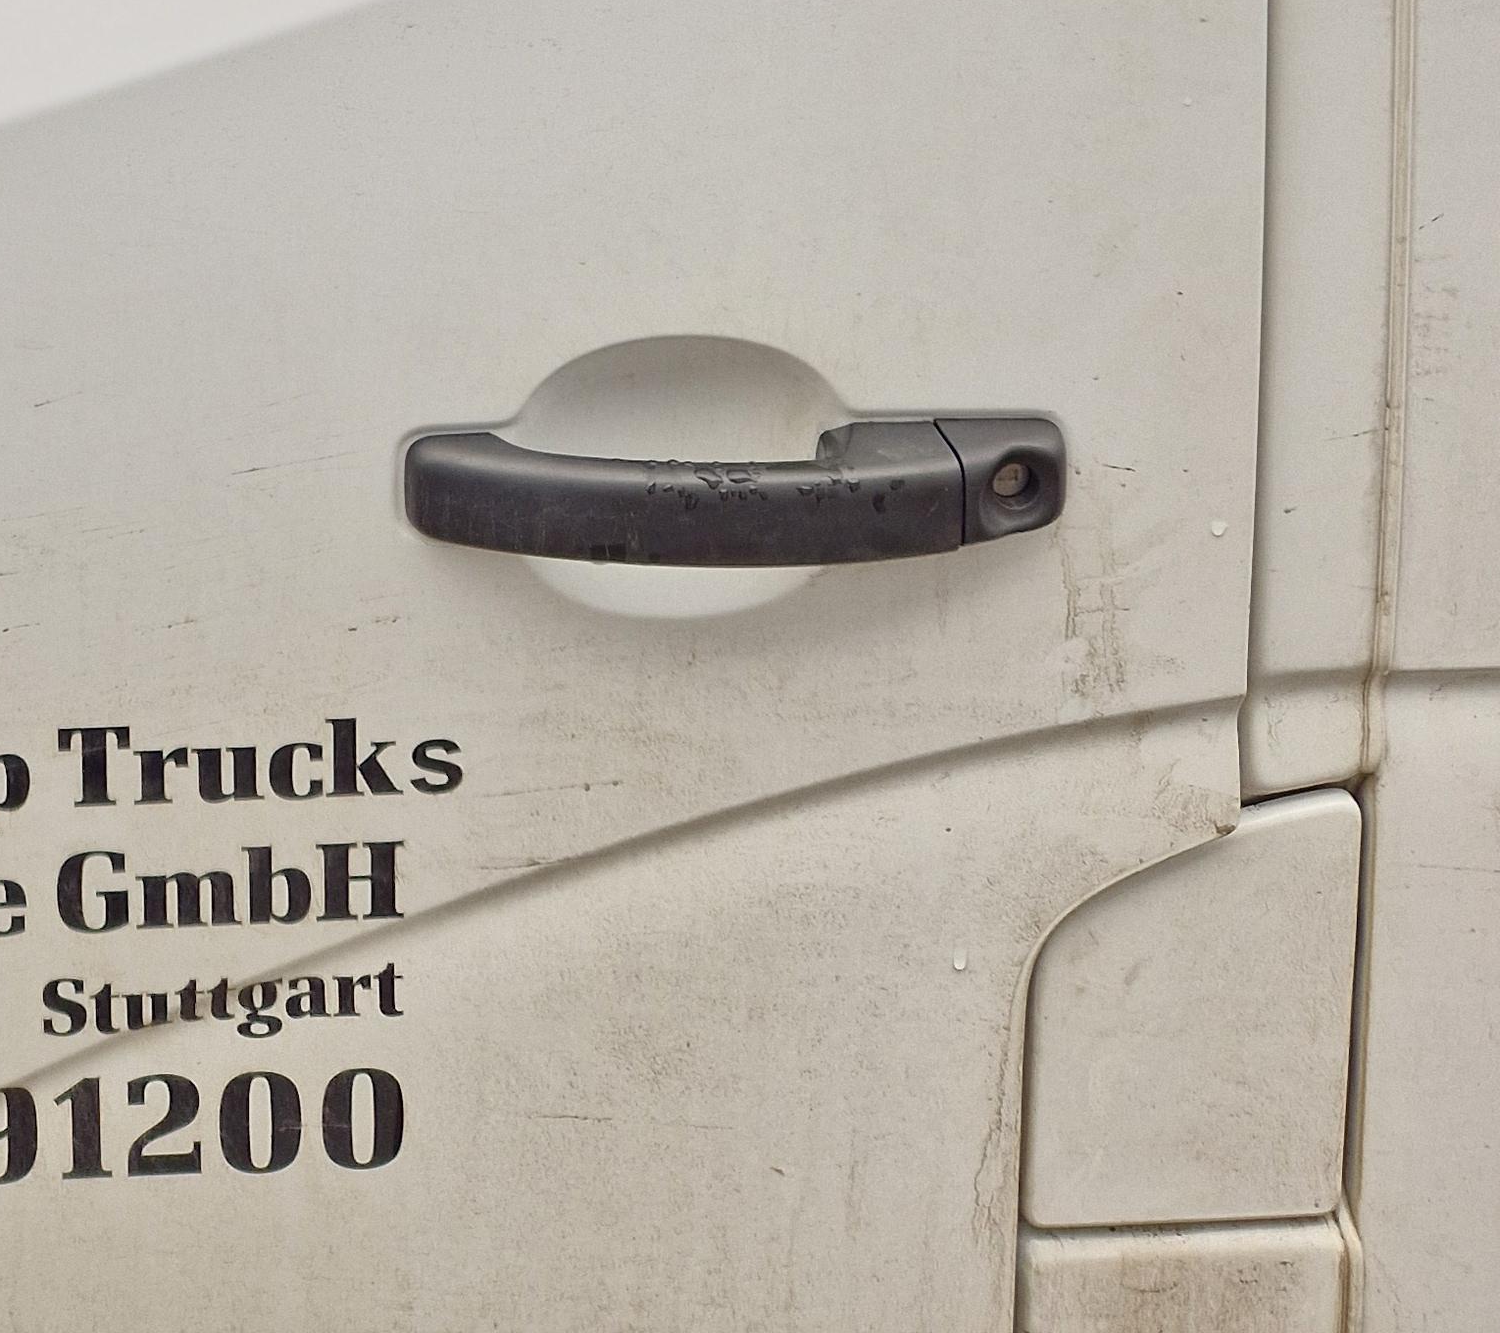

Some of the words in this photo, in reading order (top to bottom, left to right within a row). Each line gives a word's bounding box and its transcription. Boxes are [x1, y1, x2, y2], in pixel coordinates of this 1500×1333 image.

[57, 718, 463, 807] Trucks
[56, 841, 405, 933] GmbH
[42, 962, 404, 1039] Stuttgart
